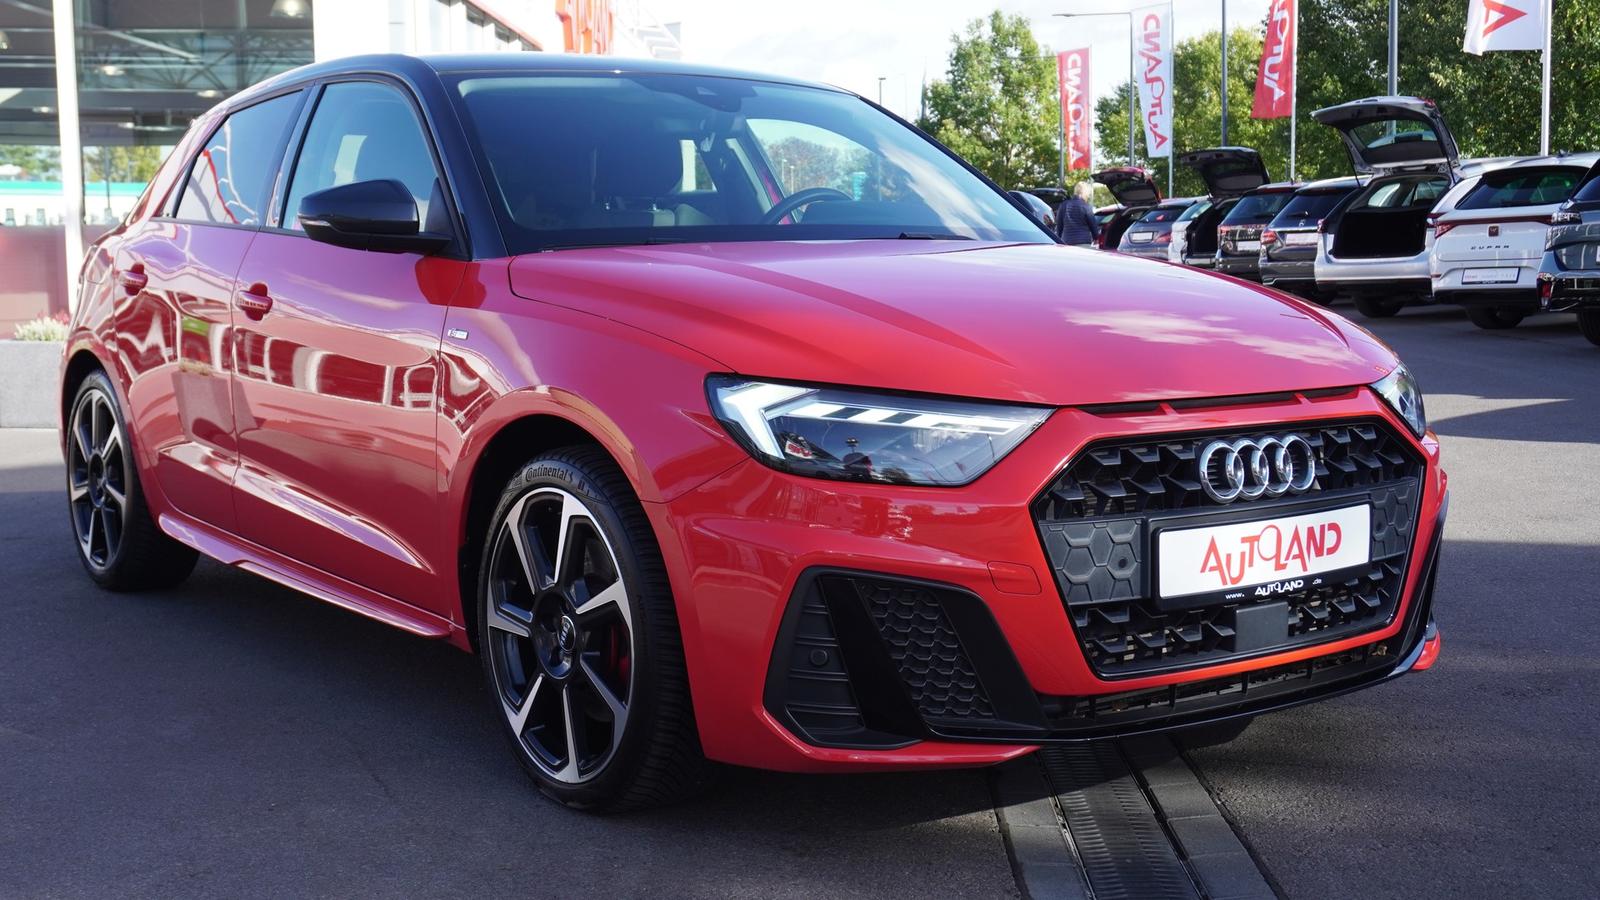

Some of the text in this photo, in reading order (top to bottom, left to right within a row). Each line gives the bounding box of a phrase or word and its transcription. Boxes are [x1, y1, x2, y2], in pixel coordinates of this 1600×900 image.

[525, 464, 569, 482] Continental
[1200, 522, 1342, 586] AUTOLAND
[1254, 579, 1304, 596] AUTOLAND
